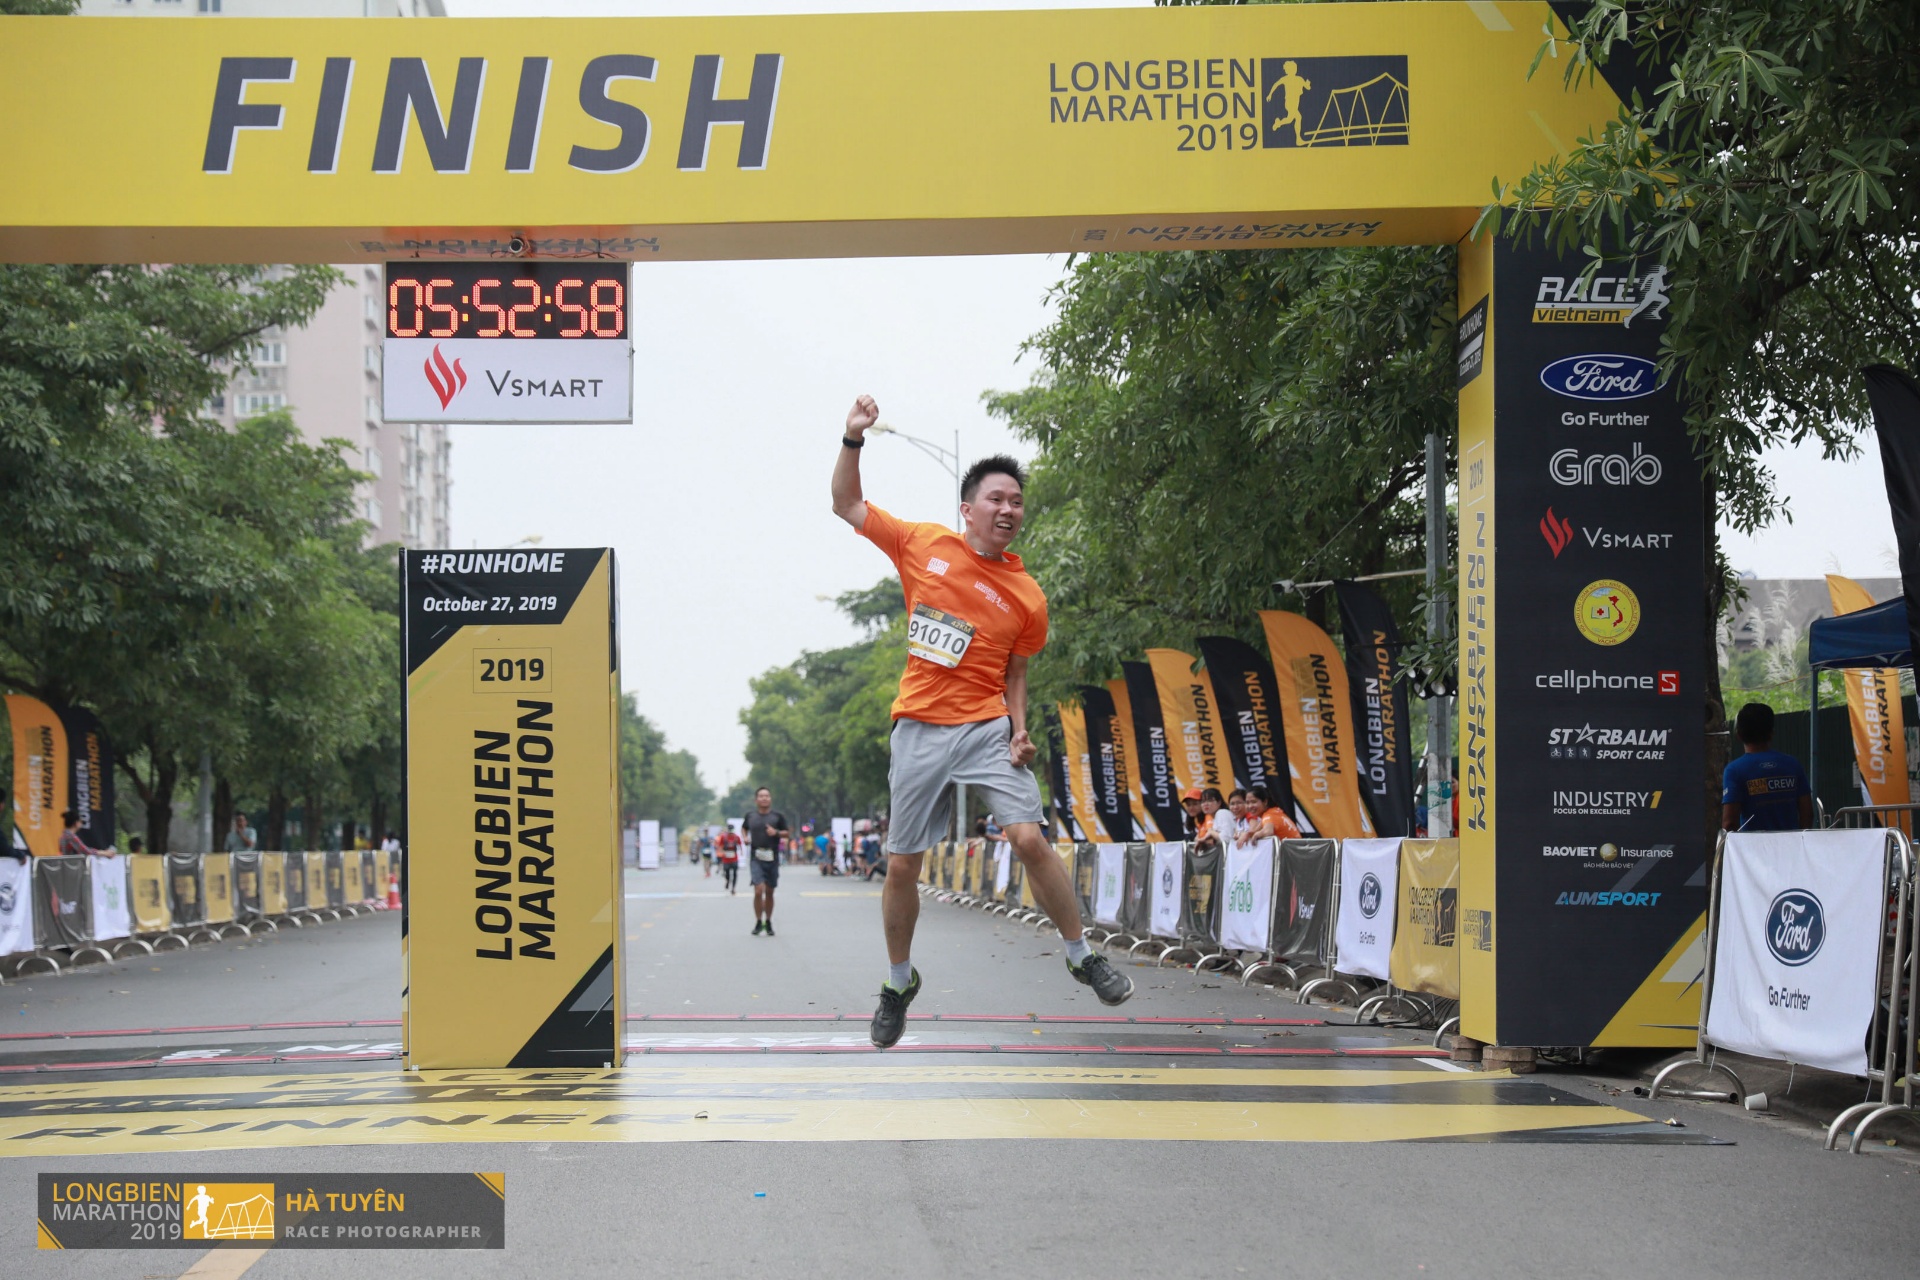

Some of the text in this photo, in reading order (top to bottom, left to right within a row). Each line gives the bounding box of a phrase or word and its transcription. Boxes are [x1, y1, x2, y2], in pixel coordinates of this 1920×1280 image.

[1049, 58, 1256, 93] LONGBIEN
[201, 53, 784, 174] FINISH
[1050, 92, 1256, 124] MARATHON
[1176, 123, 1258, 151] 2019
[1537, 276, 1641, 303] RACE
[389, 279, 623, 338] 05:52:58
[1537, 304, 1620, 322] vietnam
[1565, 360, 1644, 392] Ford
[1561, 412, 1650, 426] Go Further
[1469, 458, 1484, 490] 2019
[1549, 442, 1662, 486] Grab
[421, 553, 565, 574] #RUNHOME
[423, 597, 557, 613] October 27, 2019
[909, 620, 966, 655] 91010
[480, 658, 544, 682] 2019
[1476, 512, 1486, 832] MARATHON
[1373, 630, 1397, 763] MARATHON
[1468, 554, 1477, 831] LONGBIEN
[1244, 671, 1279, 777] MARATHON
[1309, 654, 1342, 774] MARATHON
[1860, 670, 1887, 785] LONGBIEN
[1190, 684, 1221, 785] MARATHON
[1237, 711, 1268, 788] NGBIEN
[1300, 697, 1331, 804] LONGBIEN
[1365, 677, 1387, 795] LONGBIEN
[41, 726, 54, 809] MARATHON
[1150, 727, 1170, 807] LONGBIEN
[1182, 721, 1207, 789] NGBIEN
[1596, 749, 1666, 760] SPORT CARE
[1100, 743, 1119, 814] LONGBIEN
[1767, 778, 1796, 790] CREW
[1590, 808, 1631, 816] EXCELLENCE
[474, 729, 513, 961] LONGBIEN
[516, 699, 556, 961] MARATHON
[1542, 846, 1674, 858] BAOVIET Insurance
[1361, 880, 1379, 910] Ford
[1555, 891, 1662, 907] AUMSPORT
[1776, 901, 1814, 951] Ford
[1768, 985, 1811, 1011] Go Further
[256, 1086, 640, 1104] ELITE
[262, 1071, 686, 1088] PACER
[29, 1098, 234, 1111] ELITE
[5, 1113, 799, 1141] RUNNERS
